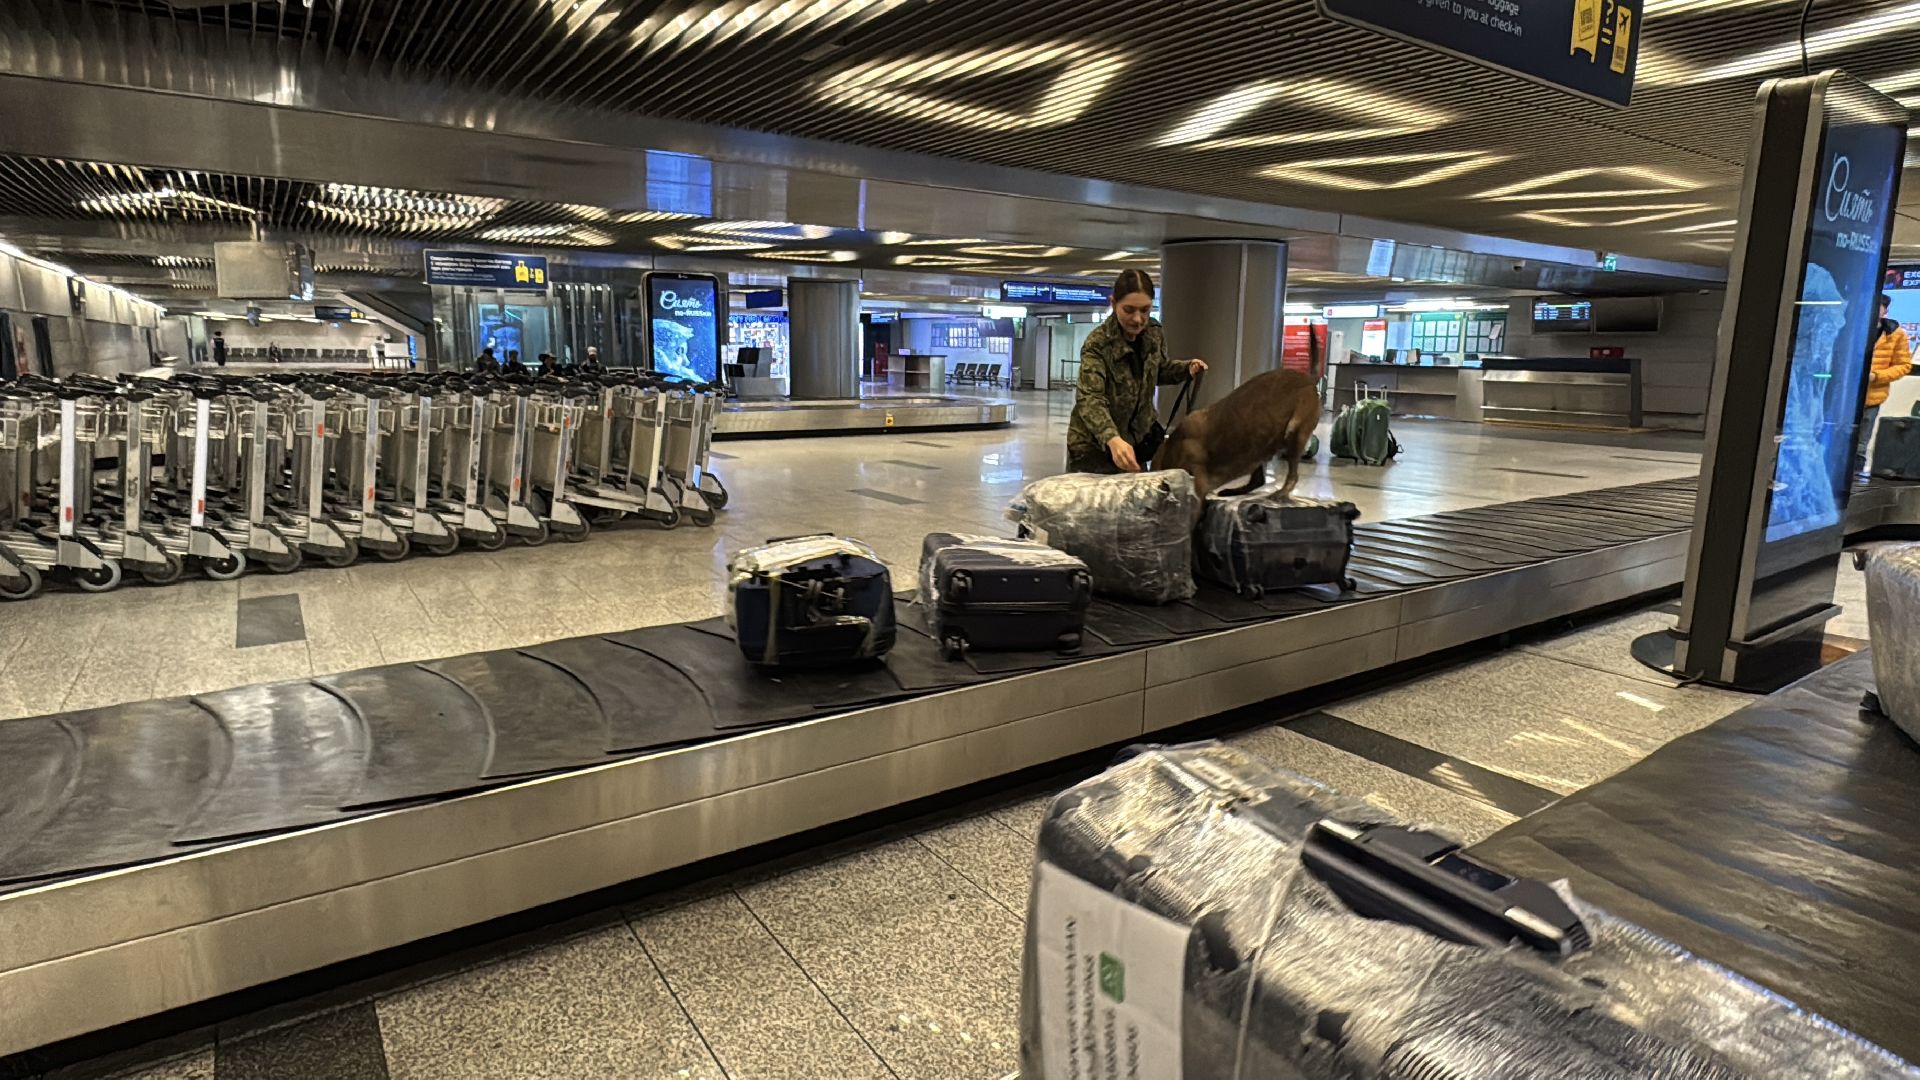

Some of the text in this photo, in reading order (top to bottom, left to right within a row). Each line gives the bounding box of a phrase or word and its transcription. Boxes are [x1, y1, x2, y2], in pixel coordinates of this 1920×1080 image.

[1452, 1, 1462, 15] to
[1463, 6, 1479, 21] you
[1480, 13, 1489, 25] at
[1490, 16, 1522, 36] check-in
